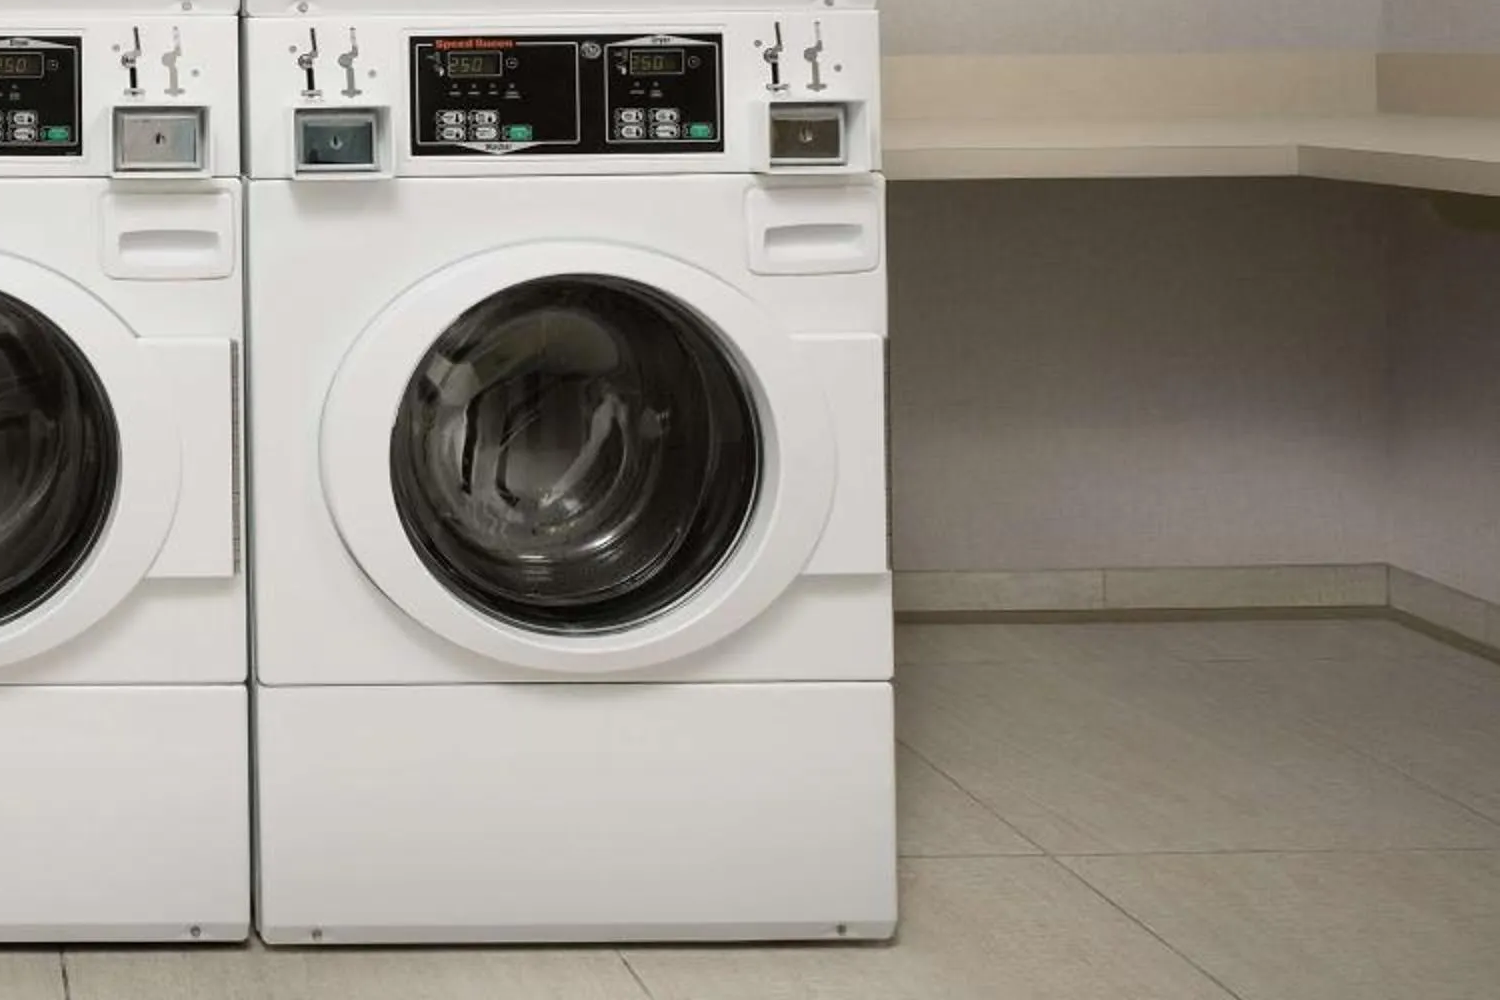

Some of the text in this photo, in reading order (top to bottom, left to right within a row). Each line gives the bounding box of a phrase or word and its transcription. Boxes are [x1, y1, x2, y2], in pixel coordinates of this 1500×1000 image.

[435, 40, 514, 49] Speed Queen
[449, 56, 483, 73] 250
